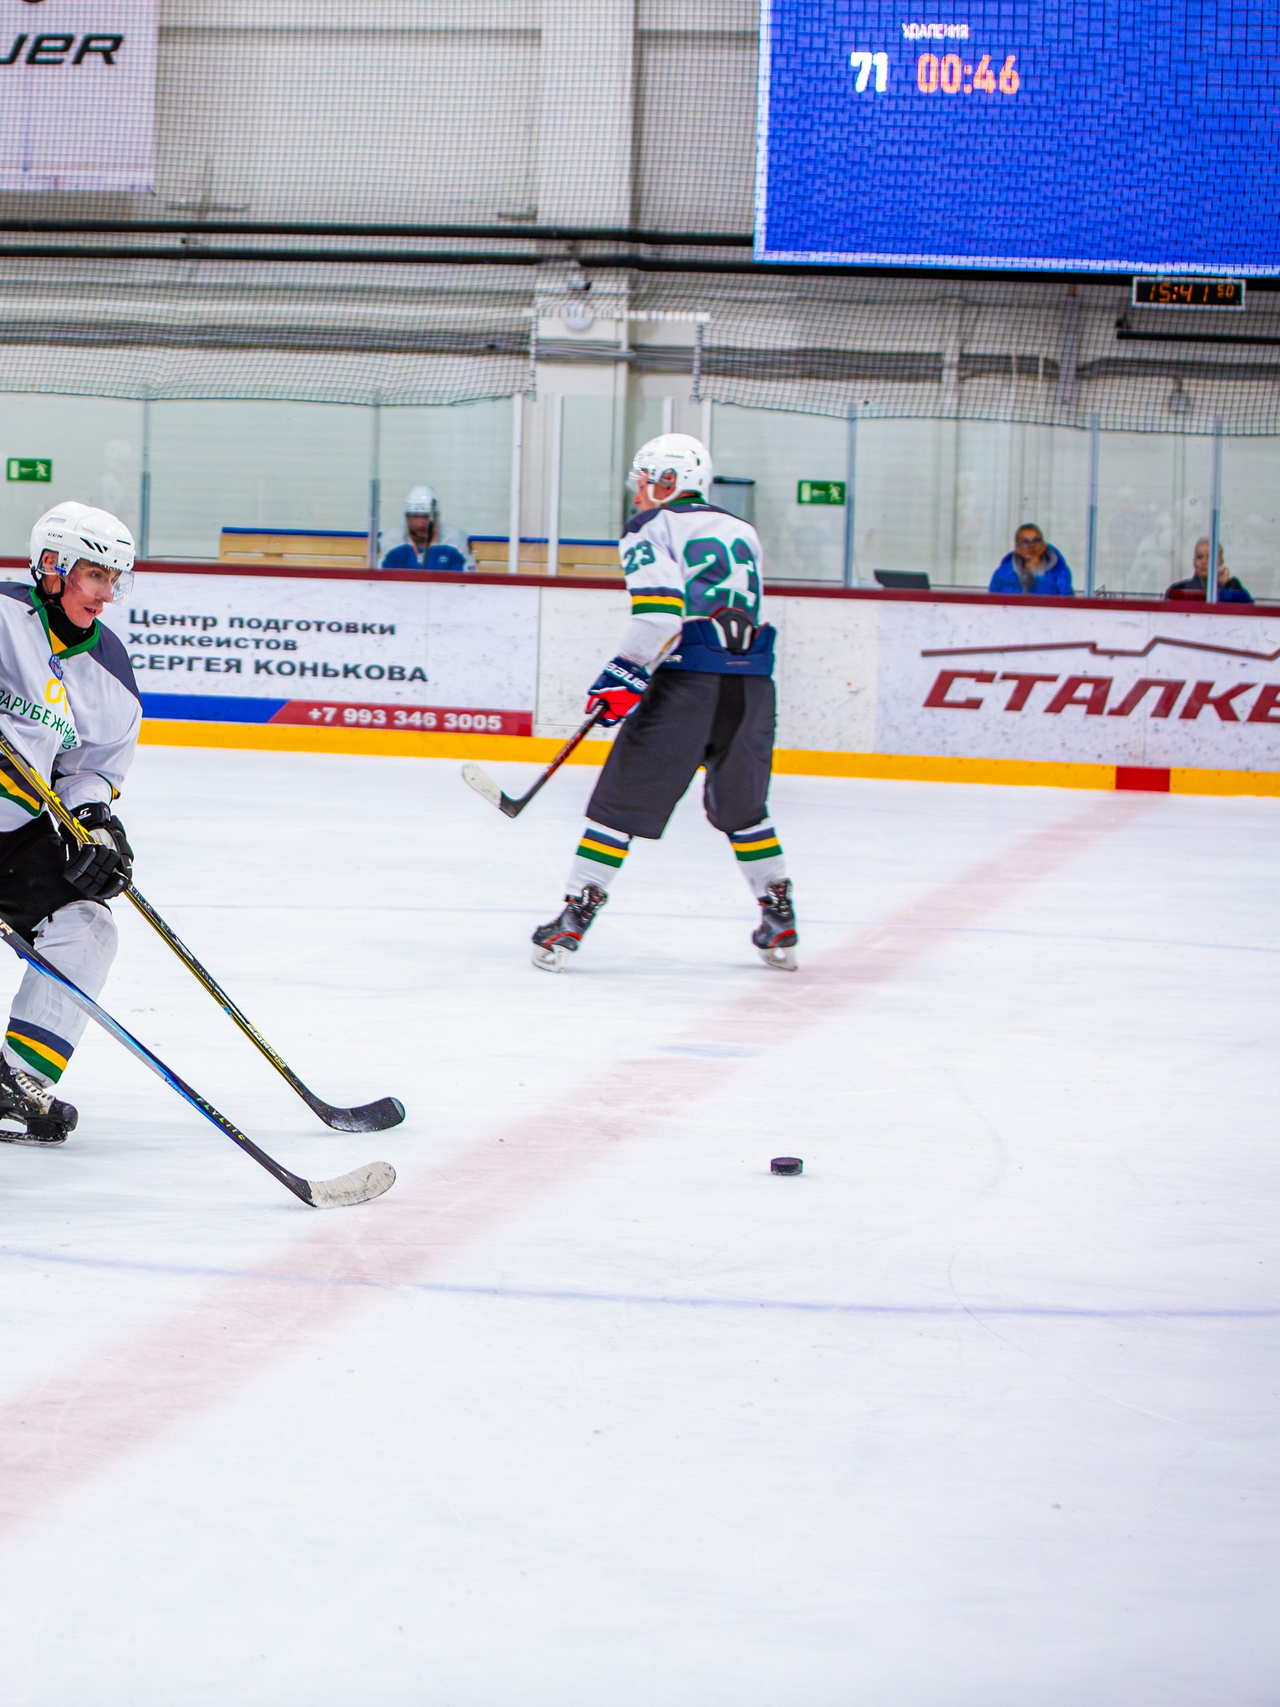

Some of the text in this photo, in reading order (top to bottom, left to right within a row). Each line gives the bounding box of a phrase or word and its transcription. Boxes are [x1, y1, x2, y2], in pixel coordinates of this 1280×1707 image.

[850, 51, 1020, 94] 71 00:46
[1149, 282, 1209, 303] 15:41
[623, 540, 656, 576] 23
[129, 608, 396, 636] Центр подготовки
[128, 630, 298, 651] хоккеистов
[130, 653, 429, 683] СЕРГЕЯ КОНЬКОВА
[308, 706, 502, 732] +7 993 346 3005
